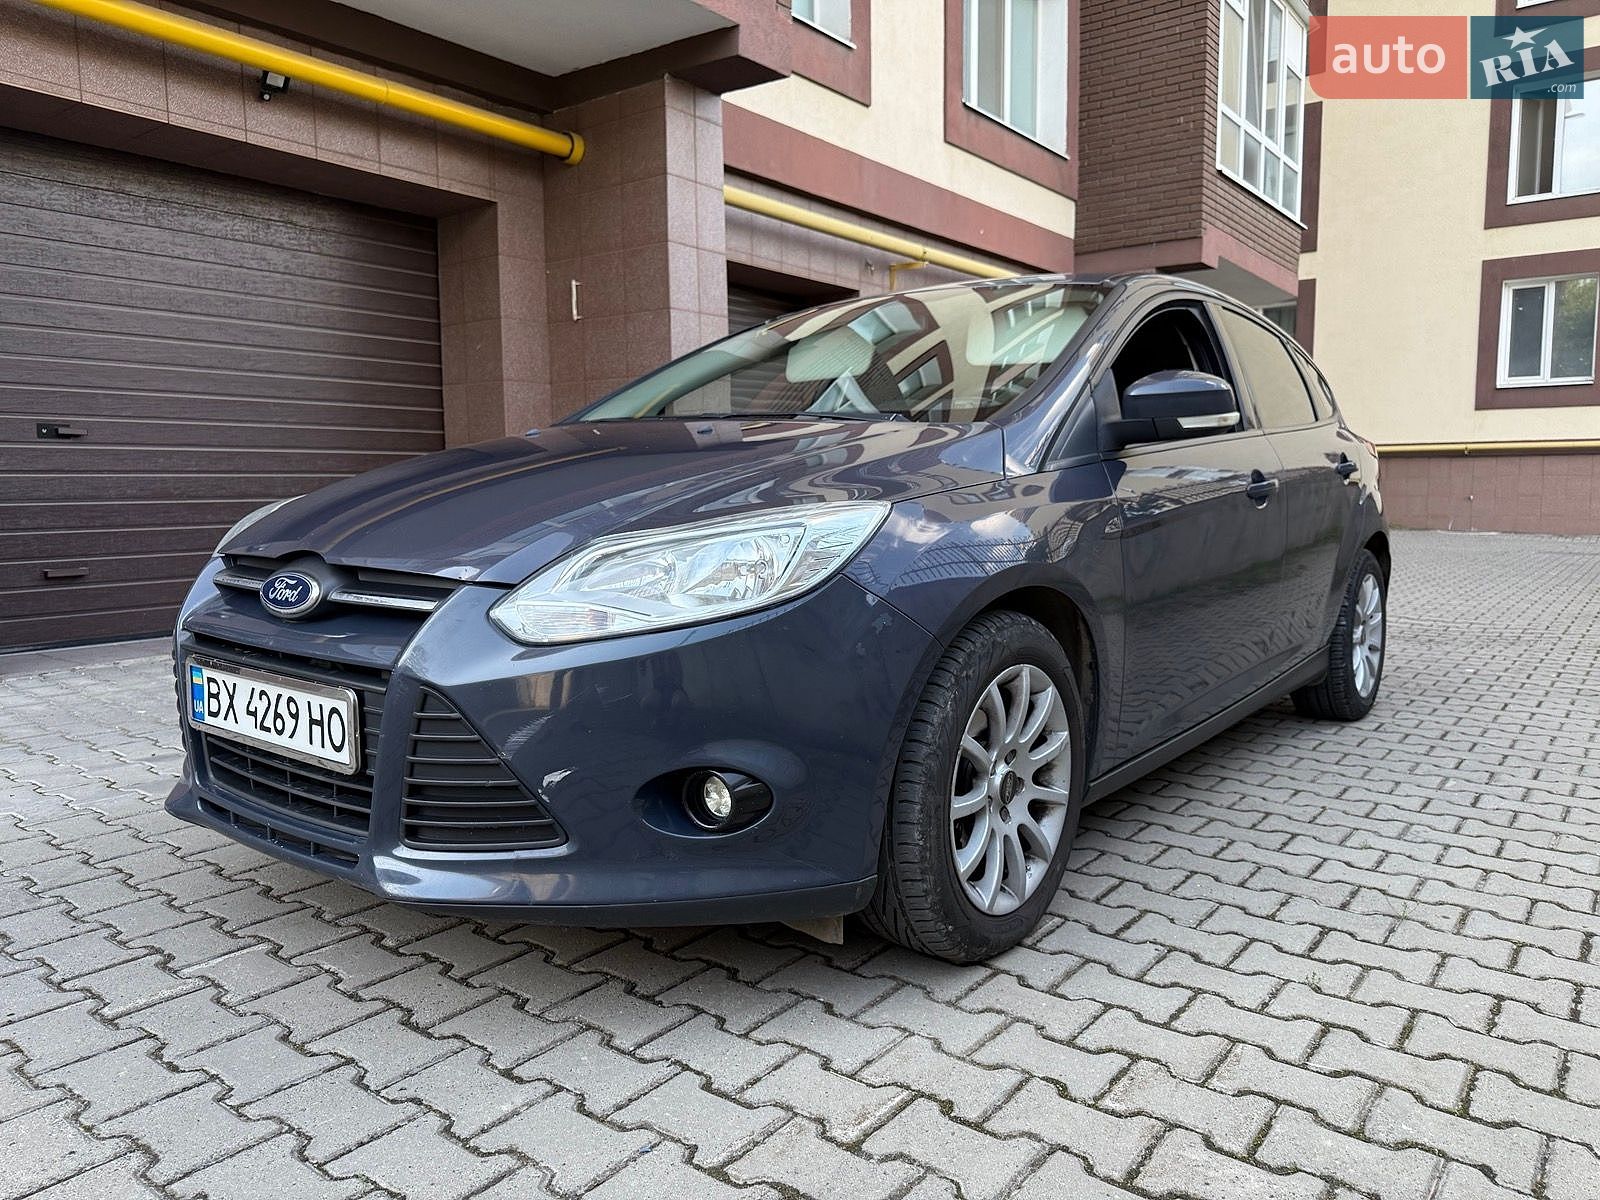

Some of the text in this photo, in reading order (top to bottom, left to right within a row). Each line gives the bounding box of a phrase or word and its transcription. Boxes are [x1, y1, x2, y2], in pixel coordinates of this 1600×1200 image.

[268, 577, 303, 602] Ford
[193, 700, 204, 714] UA
[207, 676, 346, 753] BX 4269 HO
